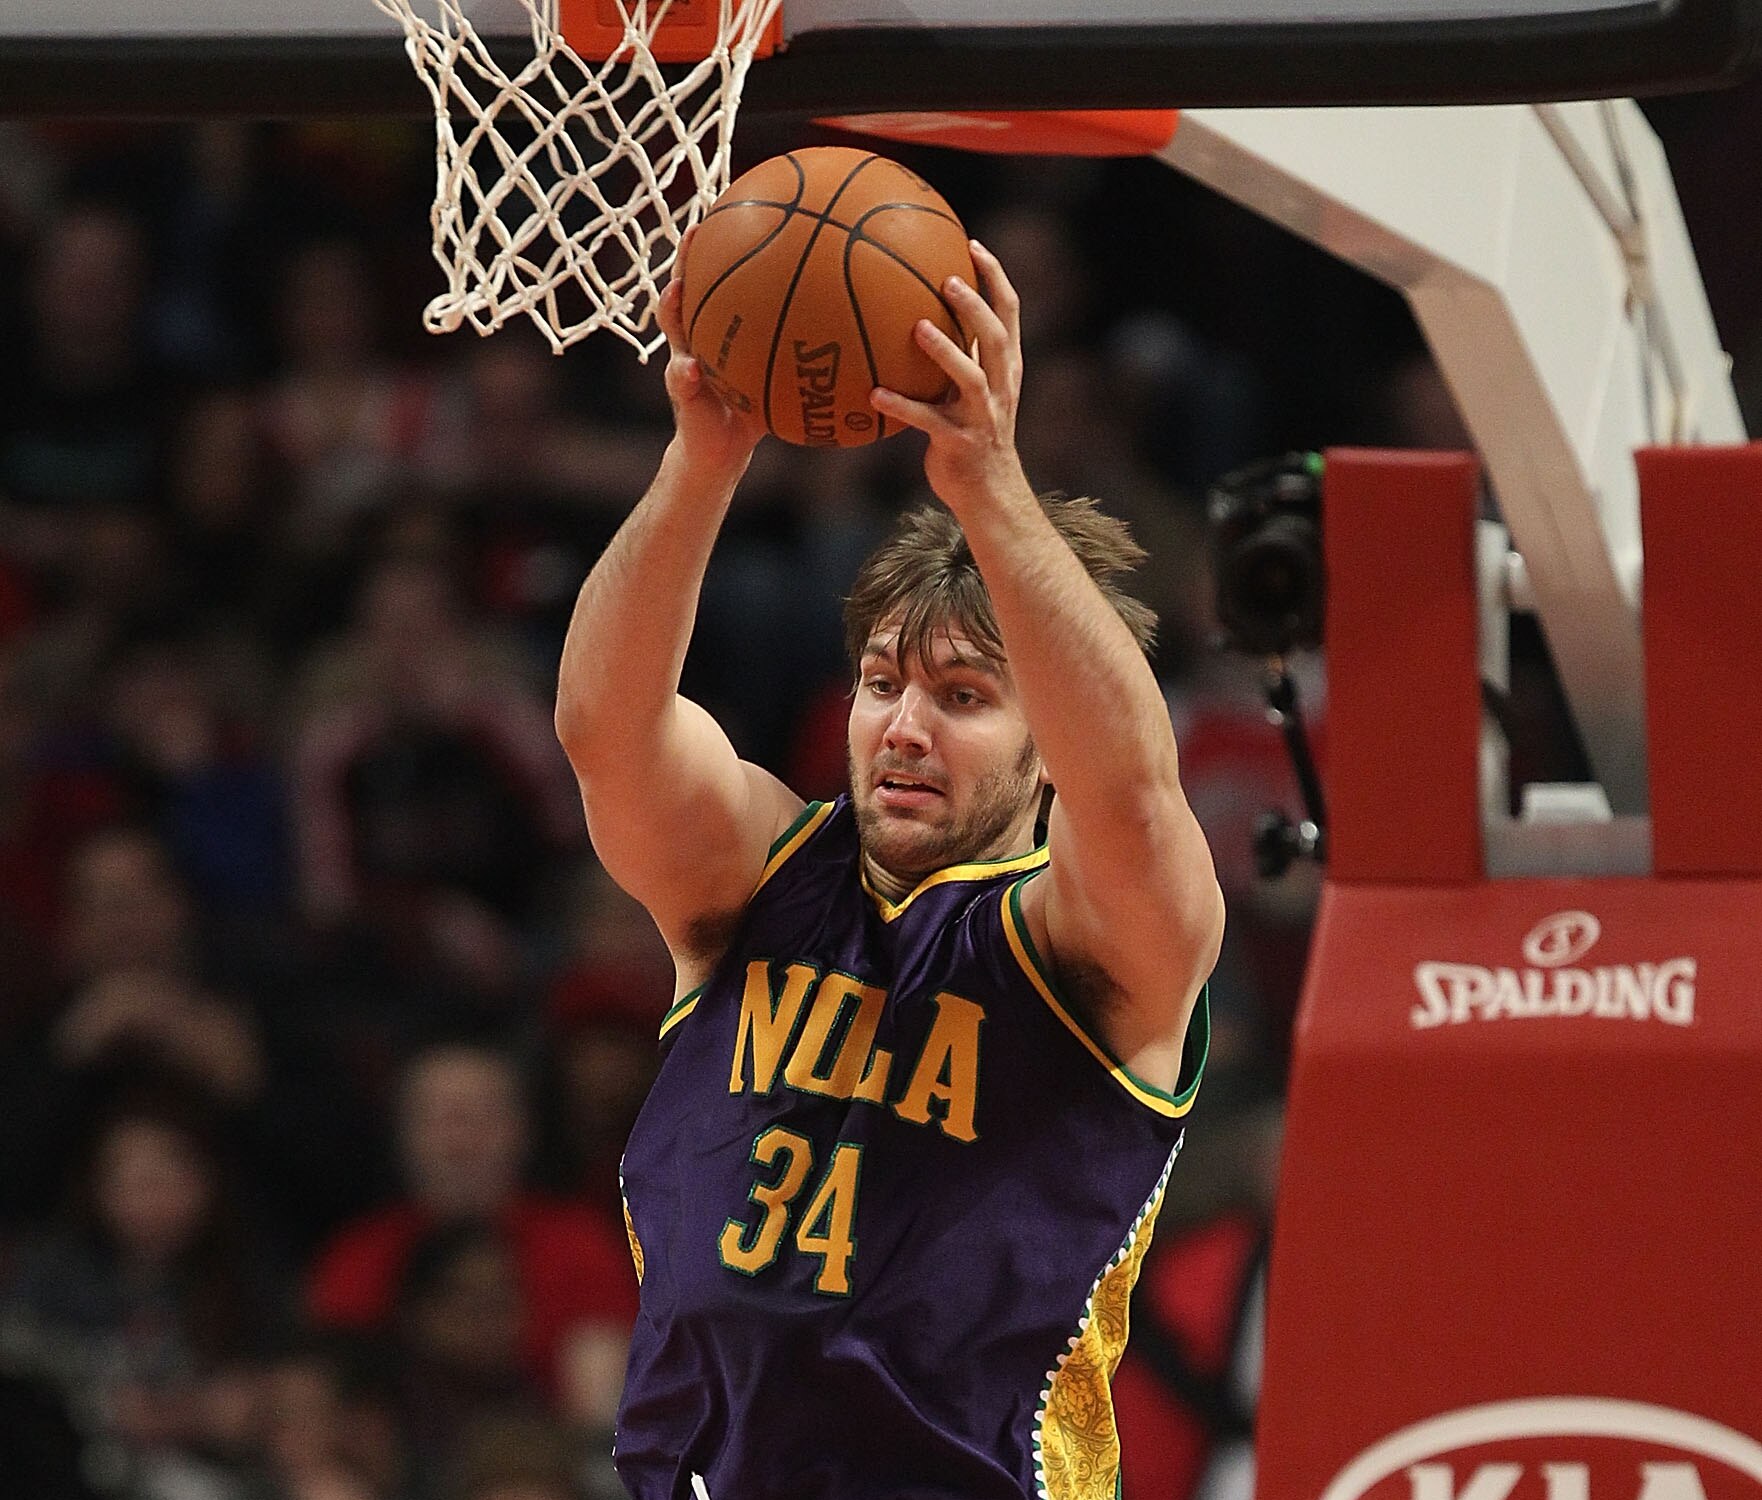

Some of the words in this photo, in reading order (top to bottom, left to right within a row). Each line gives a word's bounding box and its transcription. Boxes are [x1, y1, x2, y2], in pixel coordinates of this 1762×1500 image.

[729, 957, 986, 1144] NOLA
[1409, 955, 1698, 1029] SPALDING
[717, 1124, 864, 1297] 34
